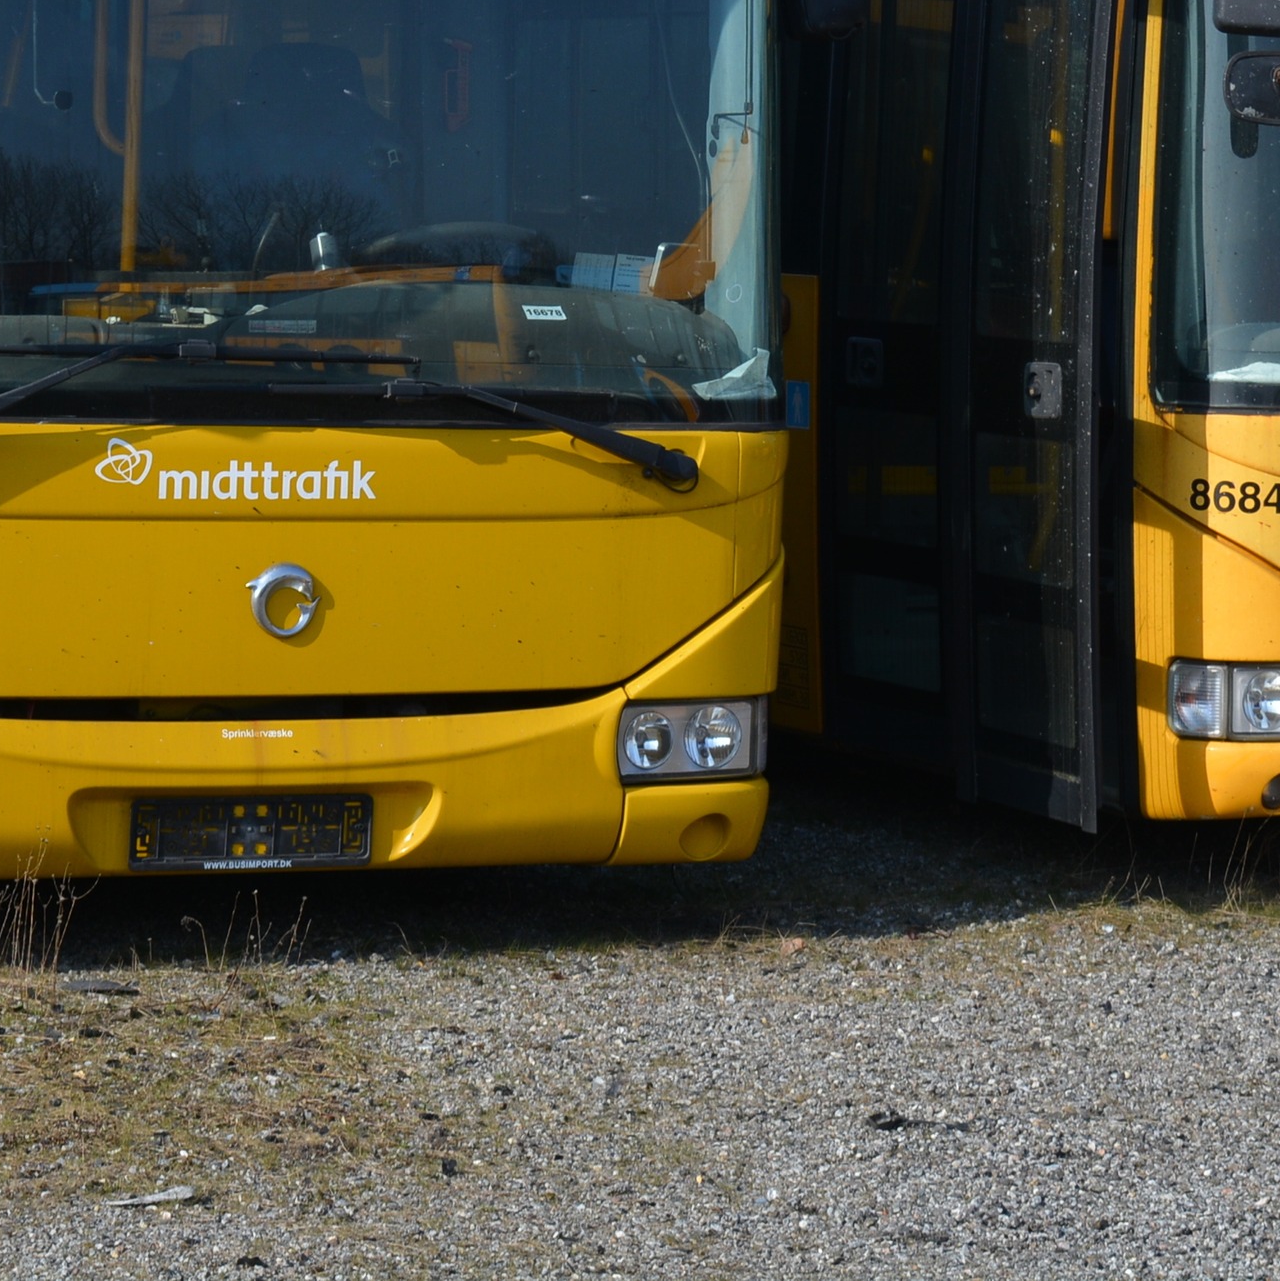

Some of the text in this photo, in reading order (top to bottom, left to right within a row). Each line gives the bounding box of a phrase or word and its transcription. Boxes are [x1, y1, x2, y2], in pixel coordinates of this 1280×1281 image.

[525, 308, 563, 317] 16678
[158, 460, 376, 500] midttrafik
[203, 859, 293, 870] WWW.BUSIMPORT.DK
